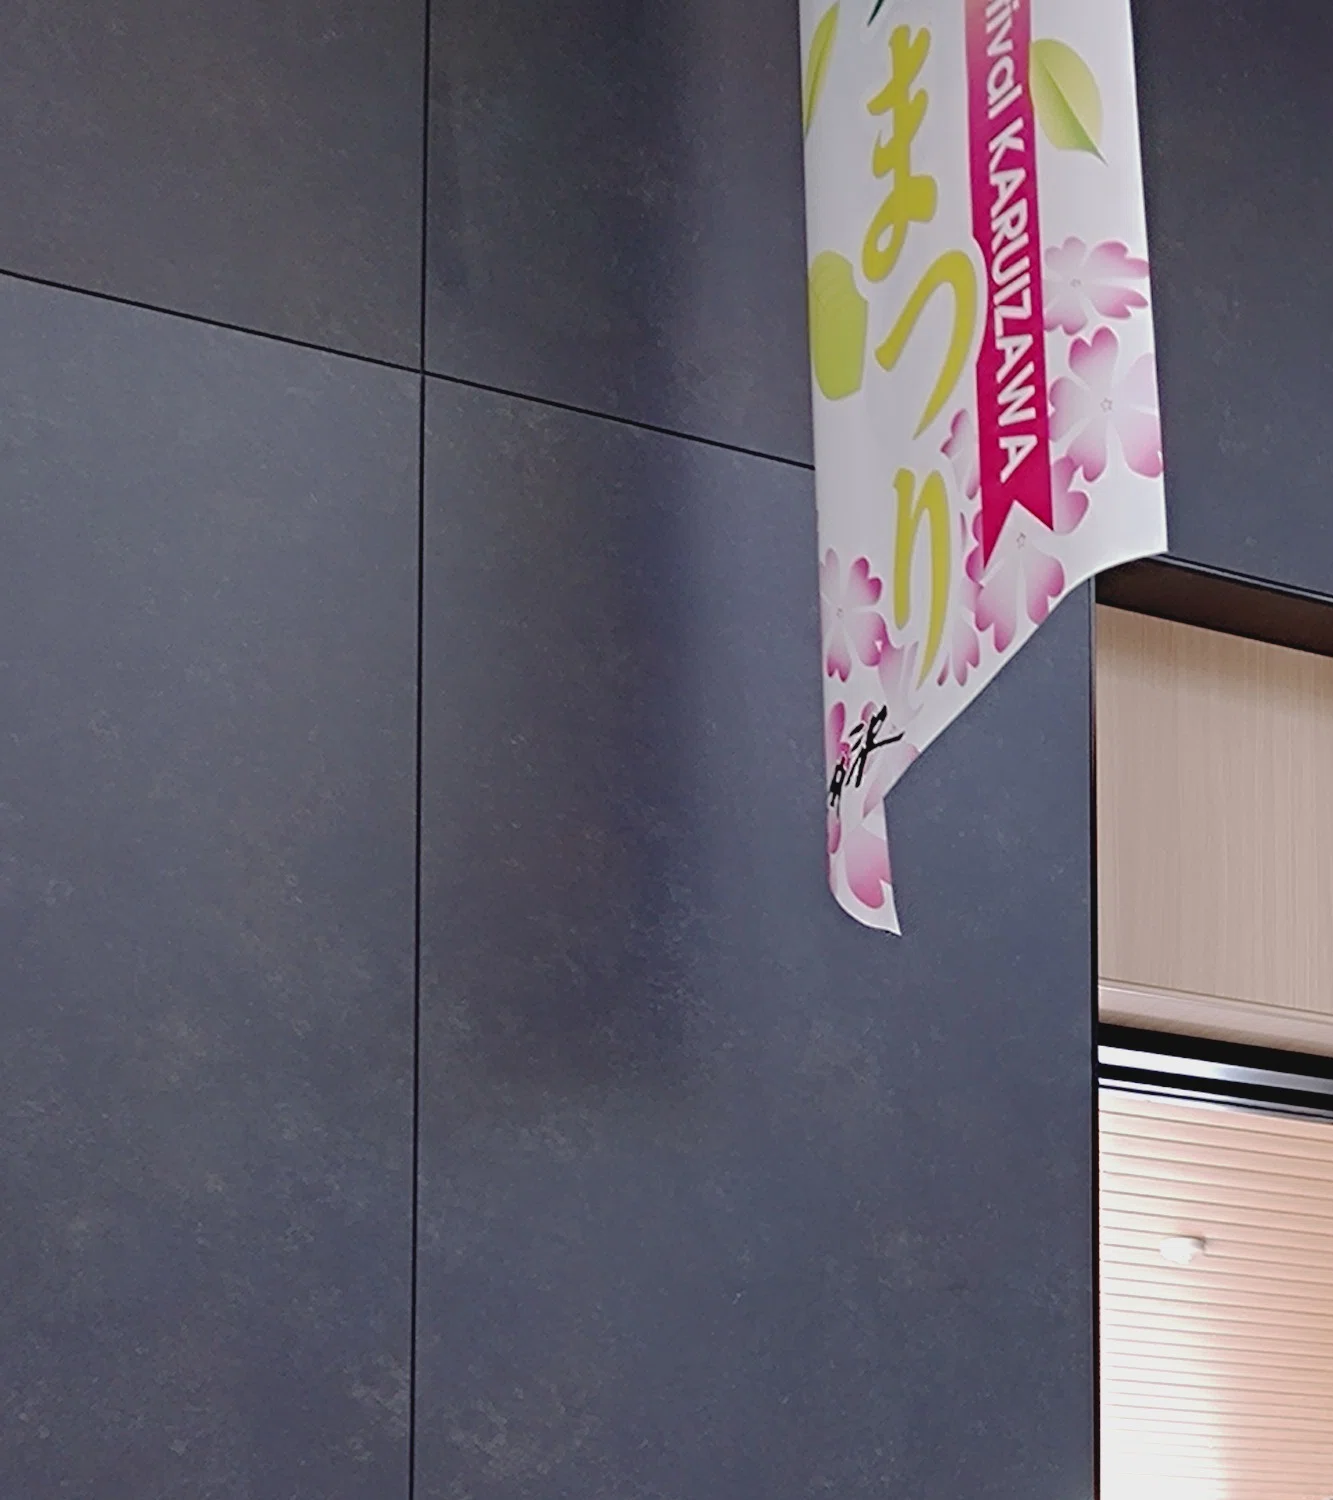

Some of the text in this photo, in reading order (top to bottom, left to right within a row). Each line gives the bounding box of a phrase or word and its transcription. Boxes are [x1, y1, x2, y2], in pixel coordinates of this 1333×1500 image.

[862, 24, 978, 690] まつり
[988, 117, 1039, 483] KARUIZAWA
